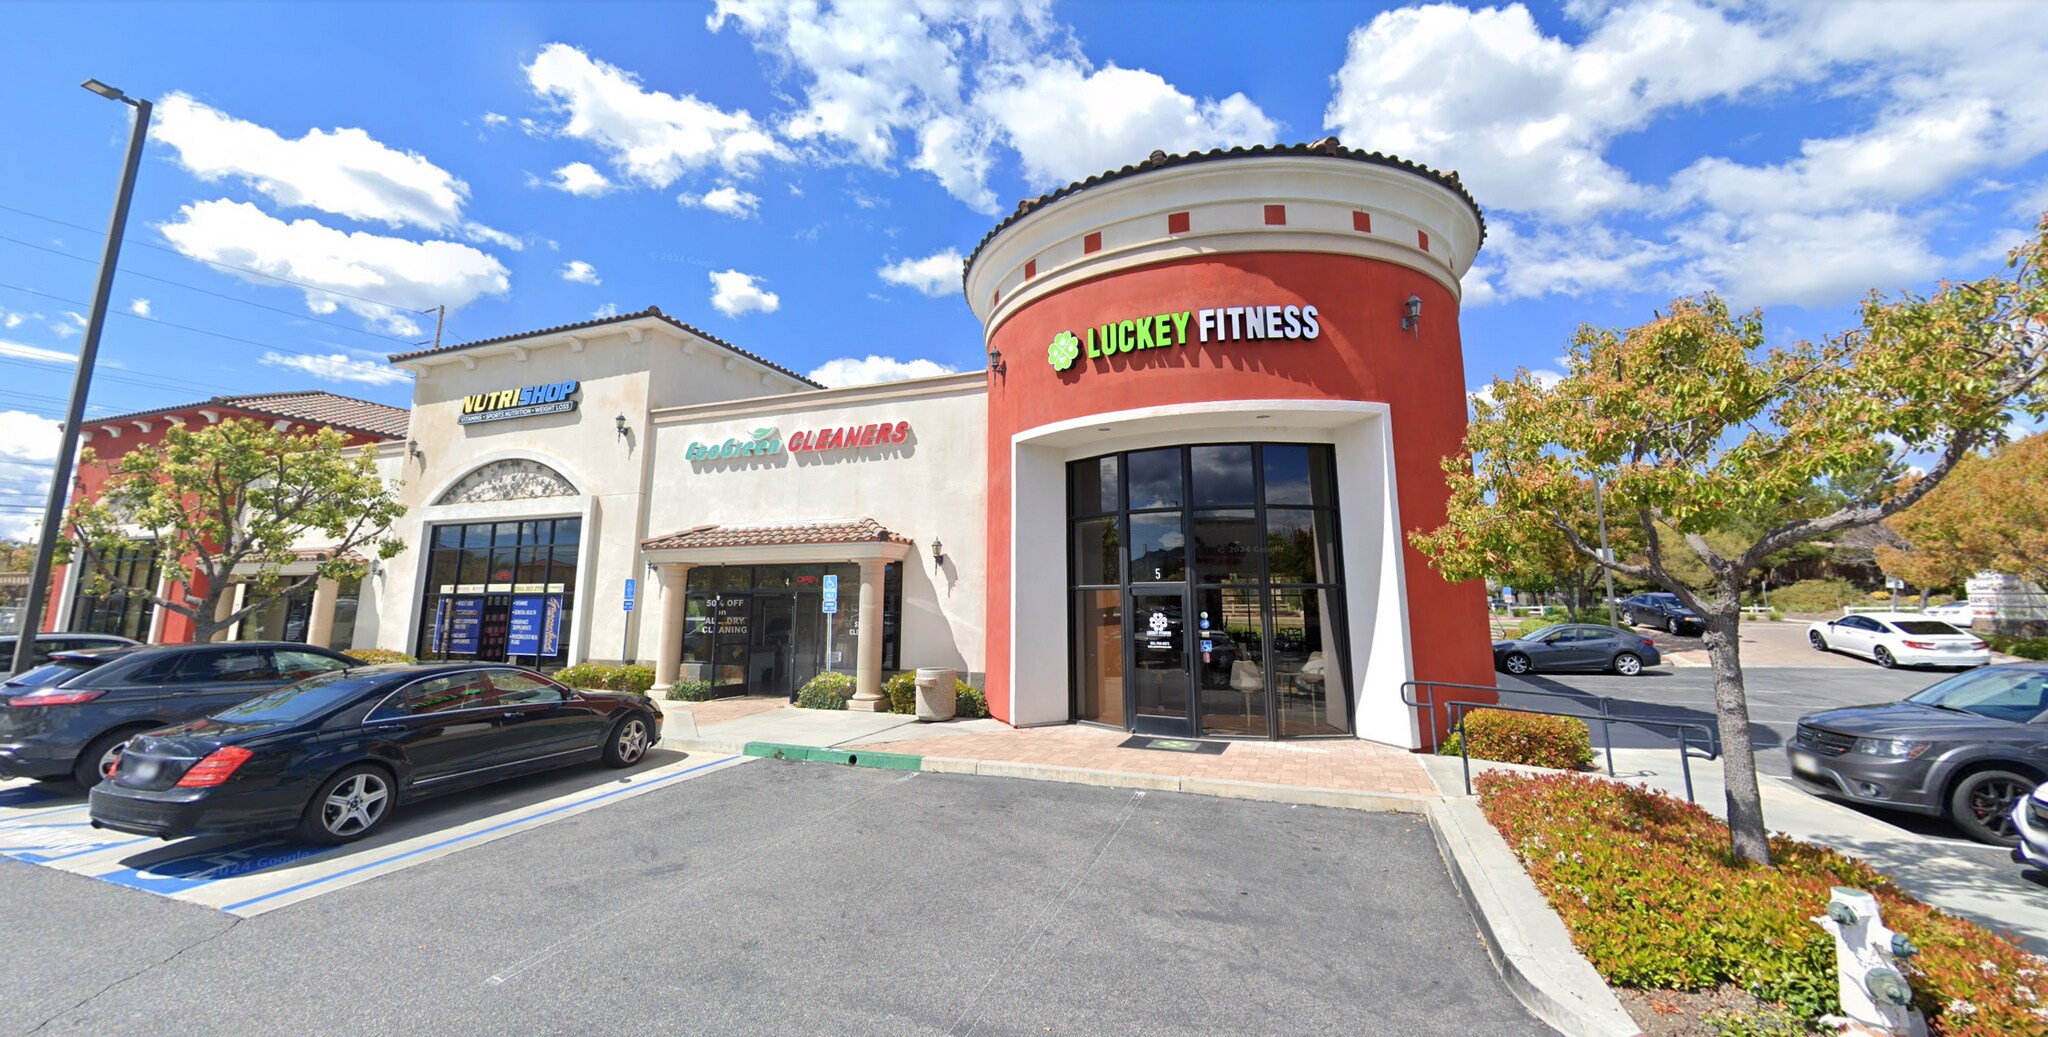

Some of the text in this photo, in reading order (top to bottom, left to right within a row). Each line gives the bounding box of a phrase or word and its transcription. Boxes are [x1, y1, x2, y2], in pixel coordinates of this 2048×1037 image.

[1087, 304, 1320, 359] LUCKEY FITNESS
[462, 381, 577, 413] NUTRISHOP
[460, 403, 570, 423] VITAMINS SPORTS NUTRITION WEIGHT LOSS
[788, 421, 910, 452] CLEANERS
[1155, 568, 1161, 579] 5
[785, 578, 790, 587] 4
[797, 575, 820, 584] OPEN
[726, 599, 744, 607] OFF
[726, 617, 745, 625] DRY
[702, 626, 747, 634] CLANING
